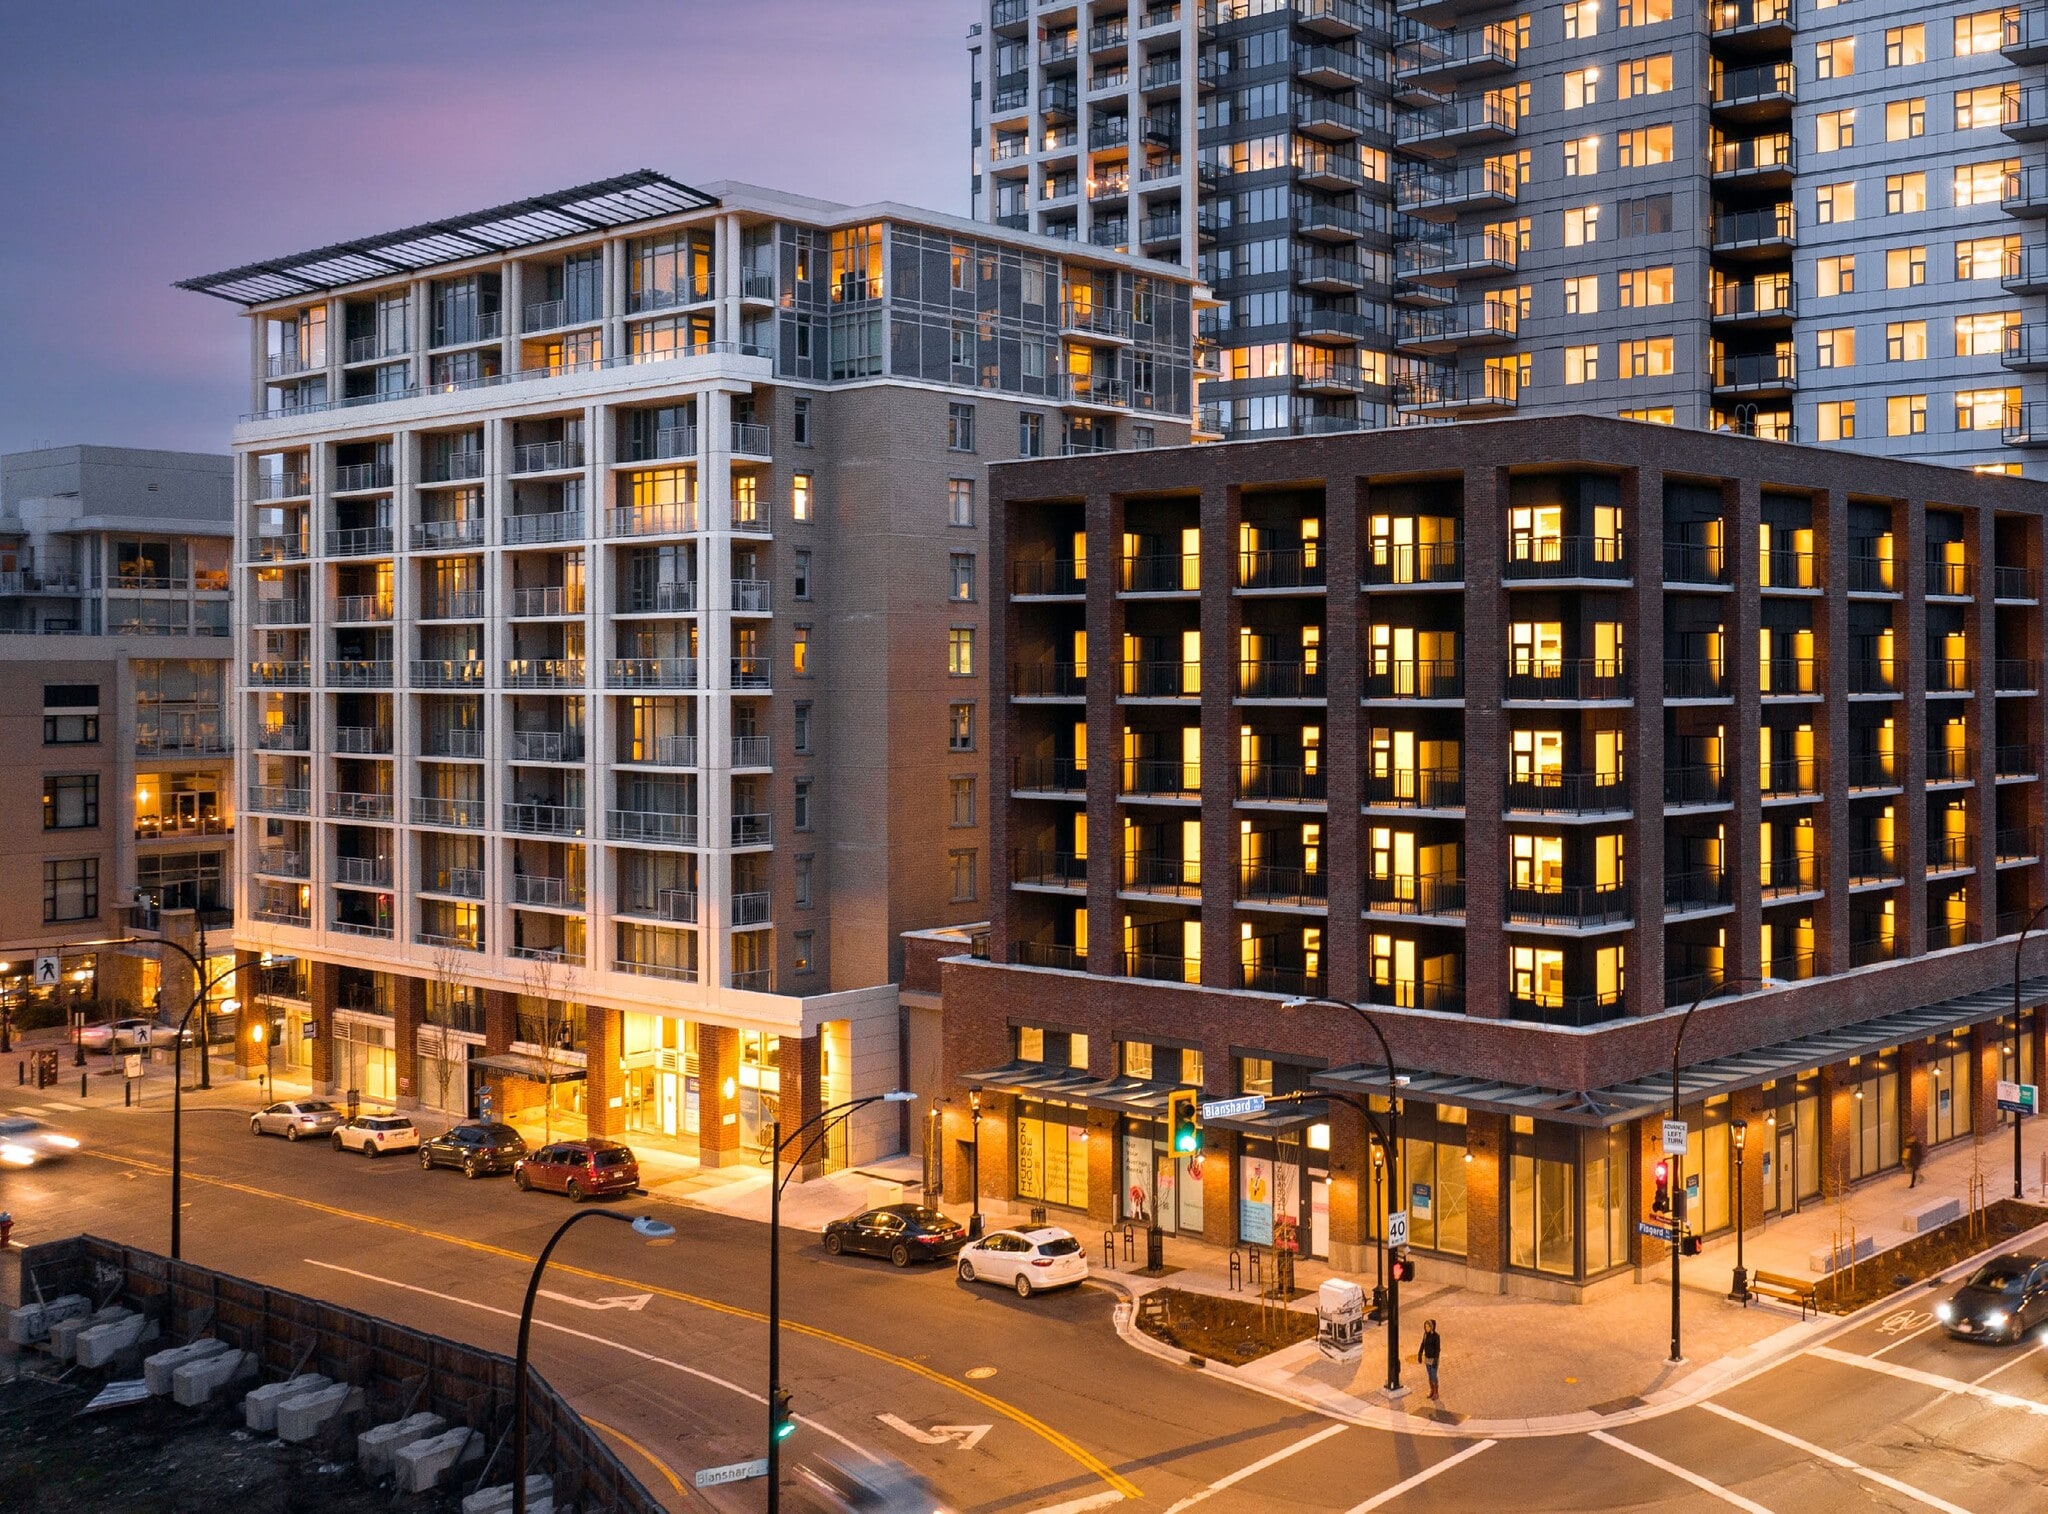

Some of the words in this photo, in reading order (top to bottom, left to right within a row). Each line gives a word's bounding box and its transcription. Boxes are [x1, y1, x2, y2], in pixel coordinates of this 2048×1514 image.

[1204, 1099, 1251, 1118] Blanshard
[1664, 1123, 1685, 1131] ADVANCE
[1667, 1137, 1683, 1145] TURN
[1390, 1220, 1405, 1237] 40
[1639, 1222, 1664, 1237] Fisgard
